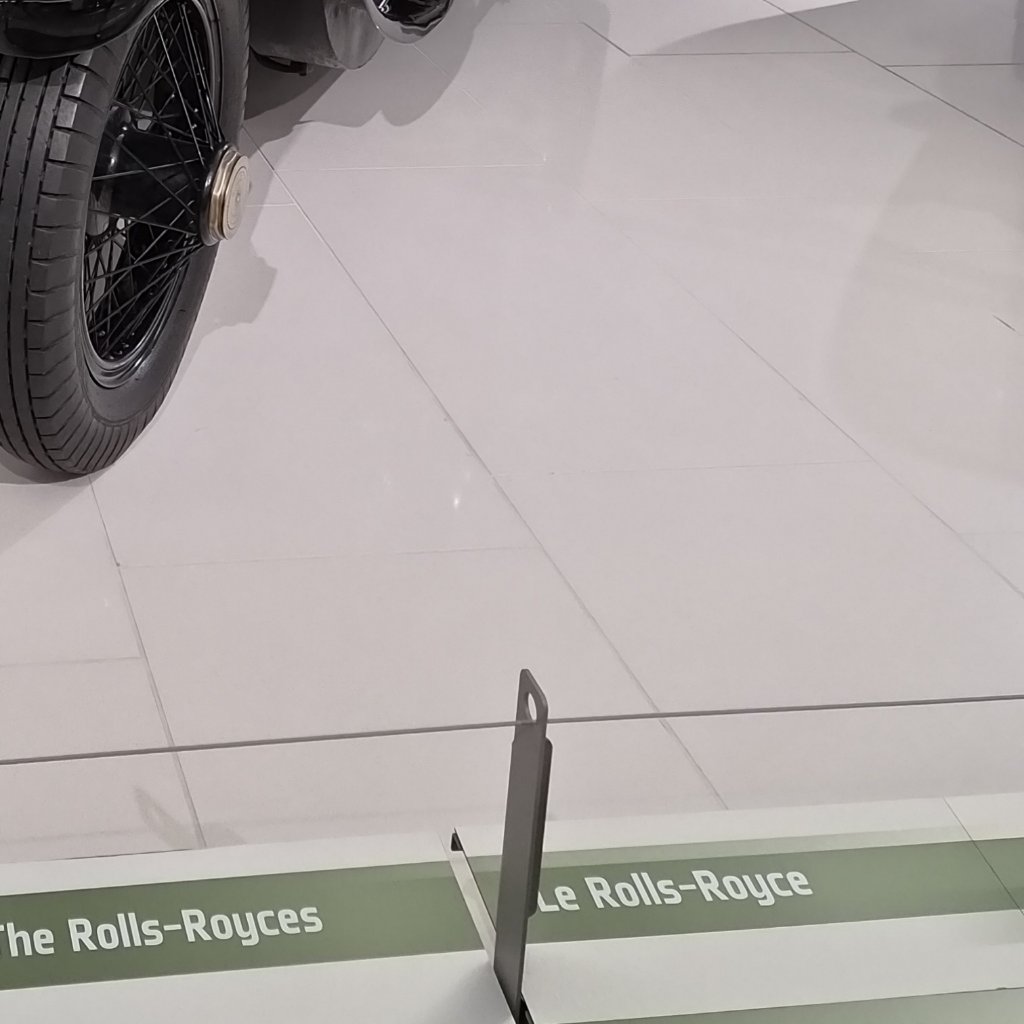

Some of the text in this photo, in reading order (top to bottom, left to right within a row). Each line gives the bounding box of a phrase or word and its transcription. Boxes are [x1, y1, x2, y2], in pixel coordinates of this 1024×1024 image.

[537, 869, 814, 913] Le Rolls-Royce
[67, 905, 324, 953] Rolls-Royces
